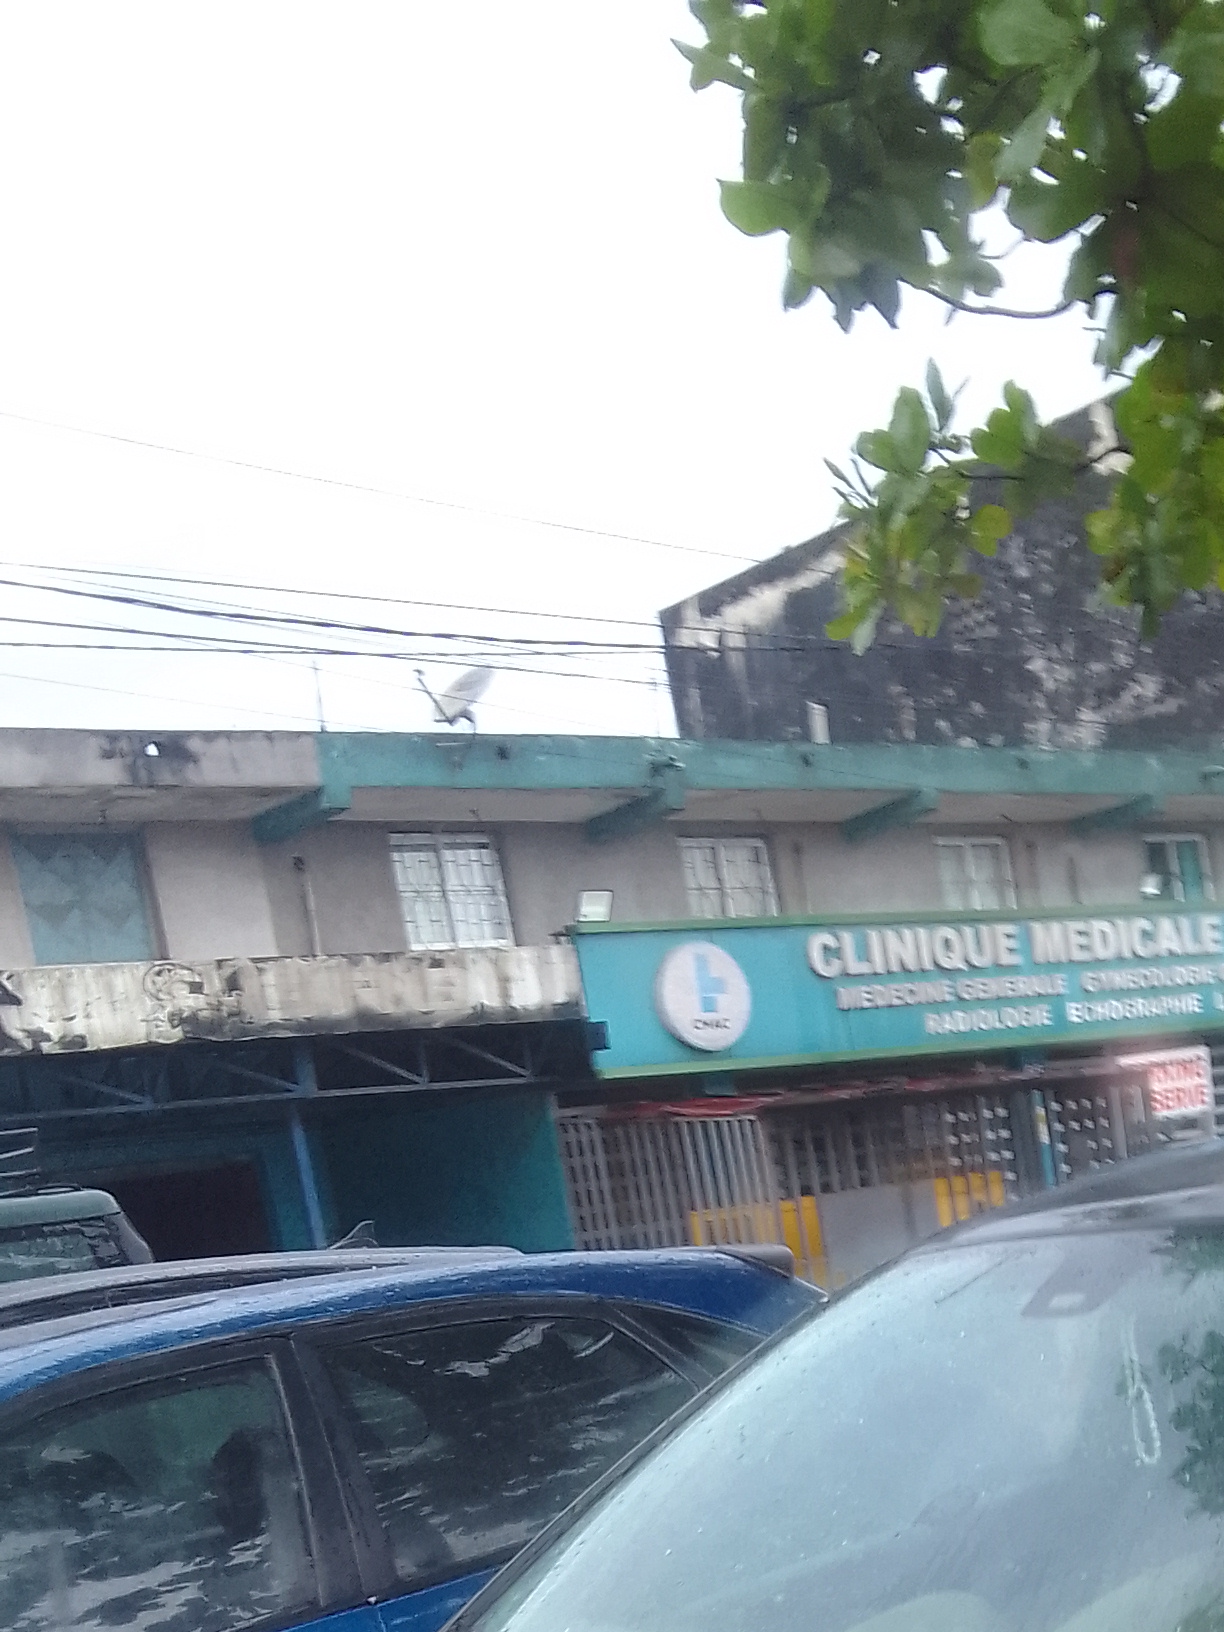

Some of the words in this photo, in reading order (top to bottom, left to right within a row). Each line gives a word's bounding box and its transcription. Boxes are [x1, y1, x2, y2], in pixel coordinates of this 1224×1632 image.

[807, 924, 1022, 979] CLINIQUE
[1029, 914, 1224, 965] MEDICALE
[924, 1003, 1053, 1035] RADIOLOGIE
[1065, 992, 1204, 1024] ECHOGRAPHIE
